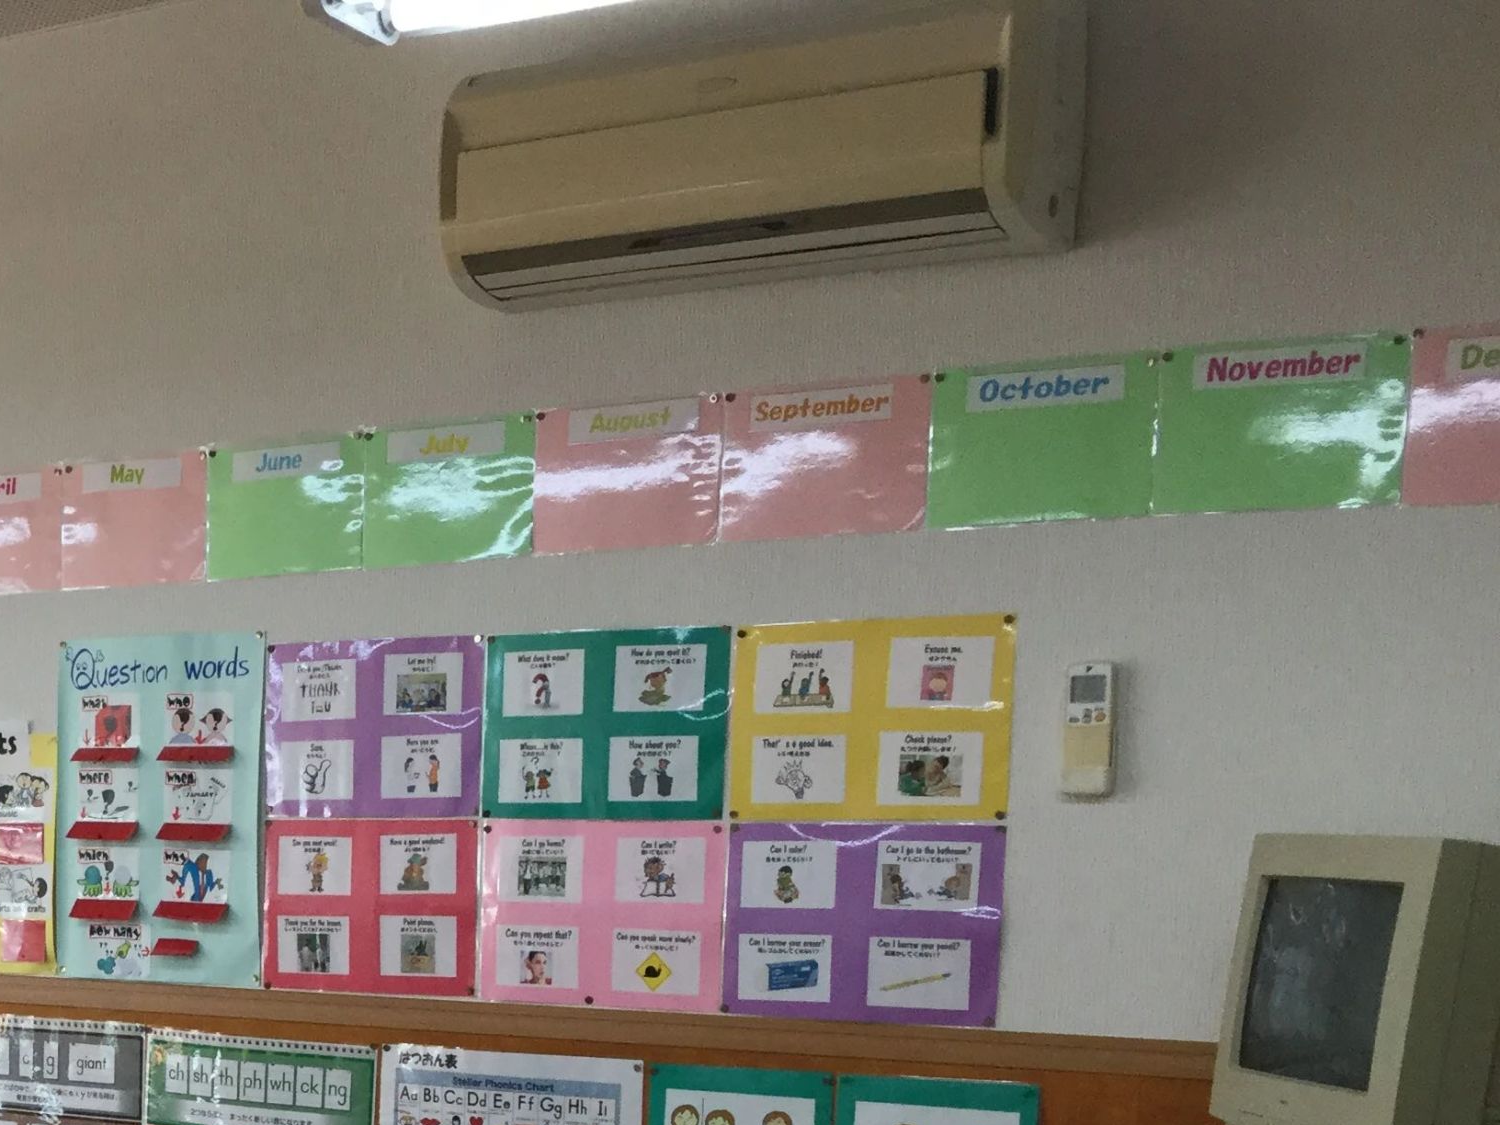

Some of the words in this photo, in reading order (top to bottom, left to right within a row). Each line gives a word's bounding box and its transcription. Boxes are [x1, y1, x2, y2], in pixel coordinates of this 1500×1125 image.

[1207, 350, 1361, 383] November
[979, 375, 1109, 402] October
[755, 394, 889, 423] September
[590, 406, 672, 433] August
[419, 434, 469, 455] July
[256, 452, 302, 472] June
[110, 463, 145, 486] May
[71, 648, 168, 690] Question
[184, 646, 249, 680] words
[505, 928, 518, 938] Can
[520, 931, 531, 939] you
[46, 1055, 55, 1075] g
[76, 1058, 107, 1076] giant
[399, 1052, 458, 1068] はつおん表
[168, 1062, 184, 1081] ch
[193, 1065, 209, 1083] sh
[218, 1067, 233, 1087] th
[270, 1072, 292, 1092] wh
[243, 1070, 262, 1096] ph
[300, 1074, 319, 1095] ck
[485, 1079, 522, 1090] Phonics
[525, 1082, 554, 1092] Chart
[328, 1083, 347, 1106] ng
[401, 1085, 418, 1101] Aa
[423, 1088, 440, 1103] Bb
[444, 1090, 463, 1106] Cc
[467, 1091, 487, 1108] Dd
[493, 1094, 510, 1110] Ee
[518, 1095, 534, 1111] Ff
[540, 1097, 562, 1119] Gg
[568, 1098, 587, 1116] Hh
[598, 1100, 608, 1117] Ii
